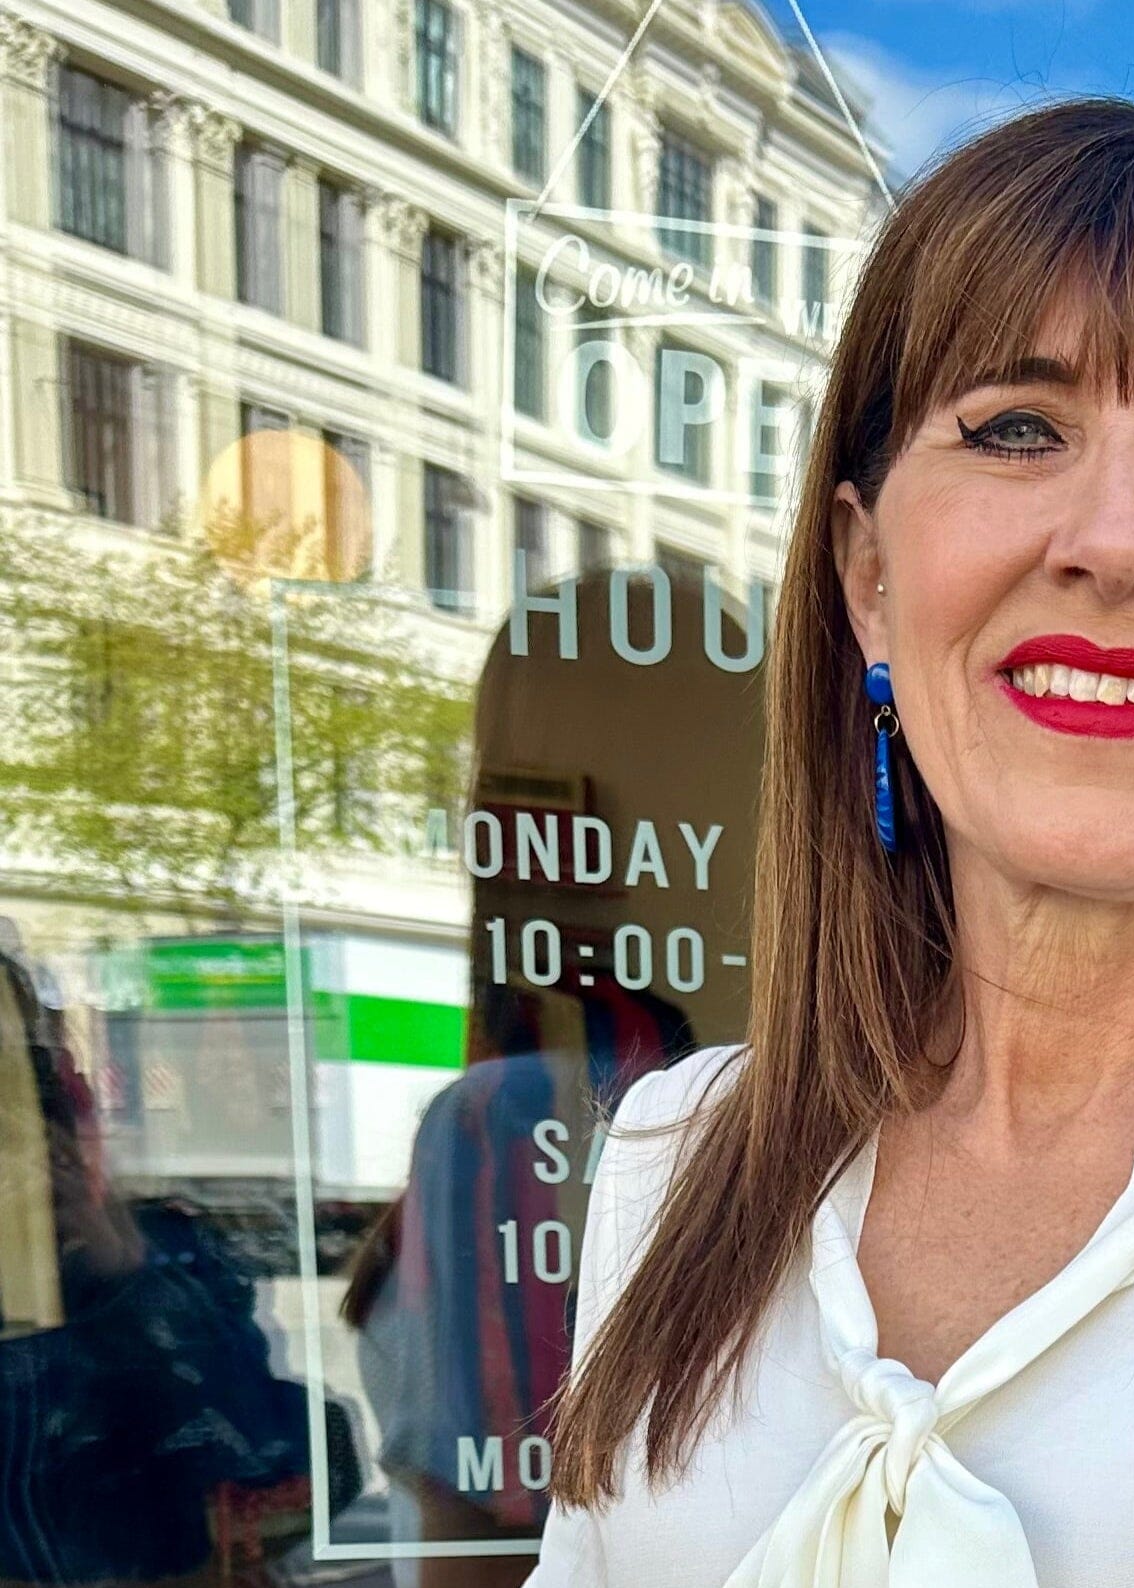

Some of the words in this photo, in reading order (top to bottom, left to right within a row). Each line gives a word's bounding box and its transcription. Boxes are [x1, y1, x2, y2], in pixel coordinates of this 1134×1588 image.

[535, 234, 694, 316] Come
[708, 256, 755, 305] in
[510, 549, 764, 673] HOU
[486, 917, 747, 993] 10:00-
[497, 1219, 572, 1284] 10
[457, 1436, 552, 1493] MO
